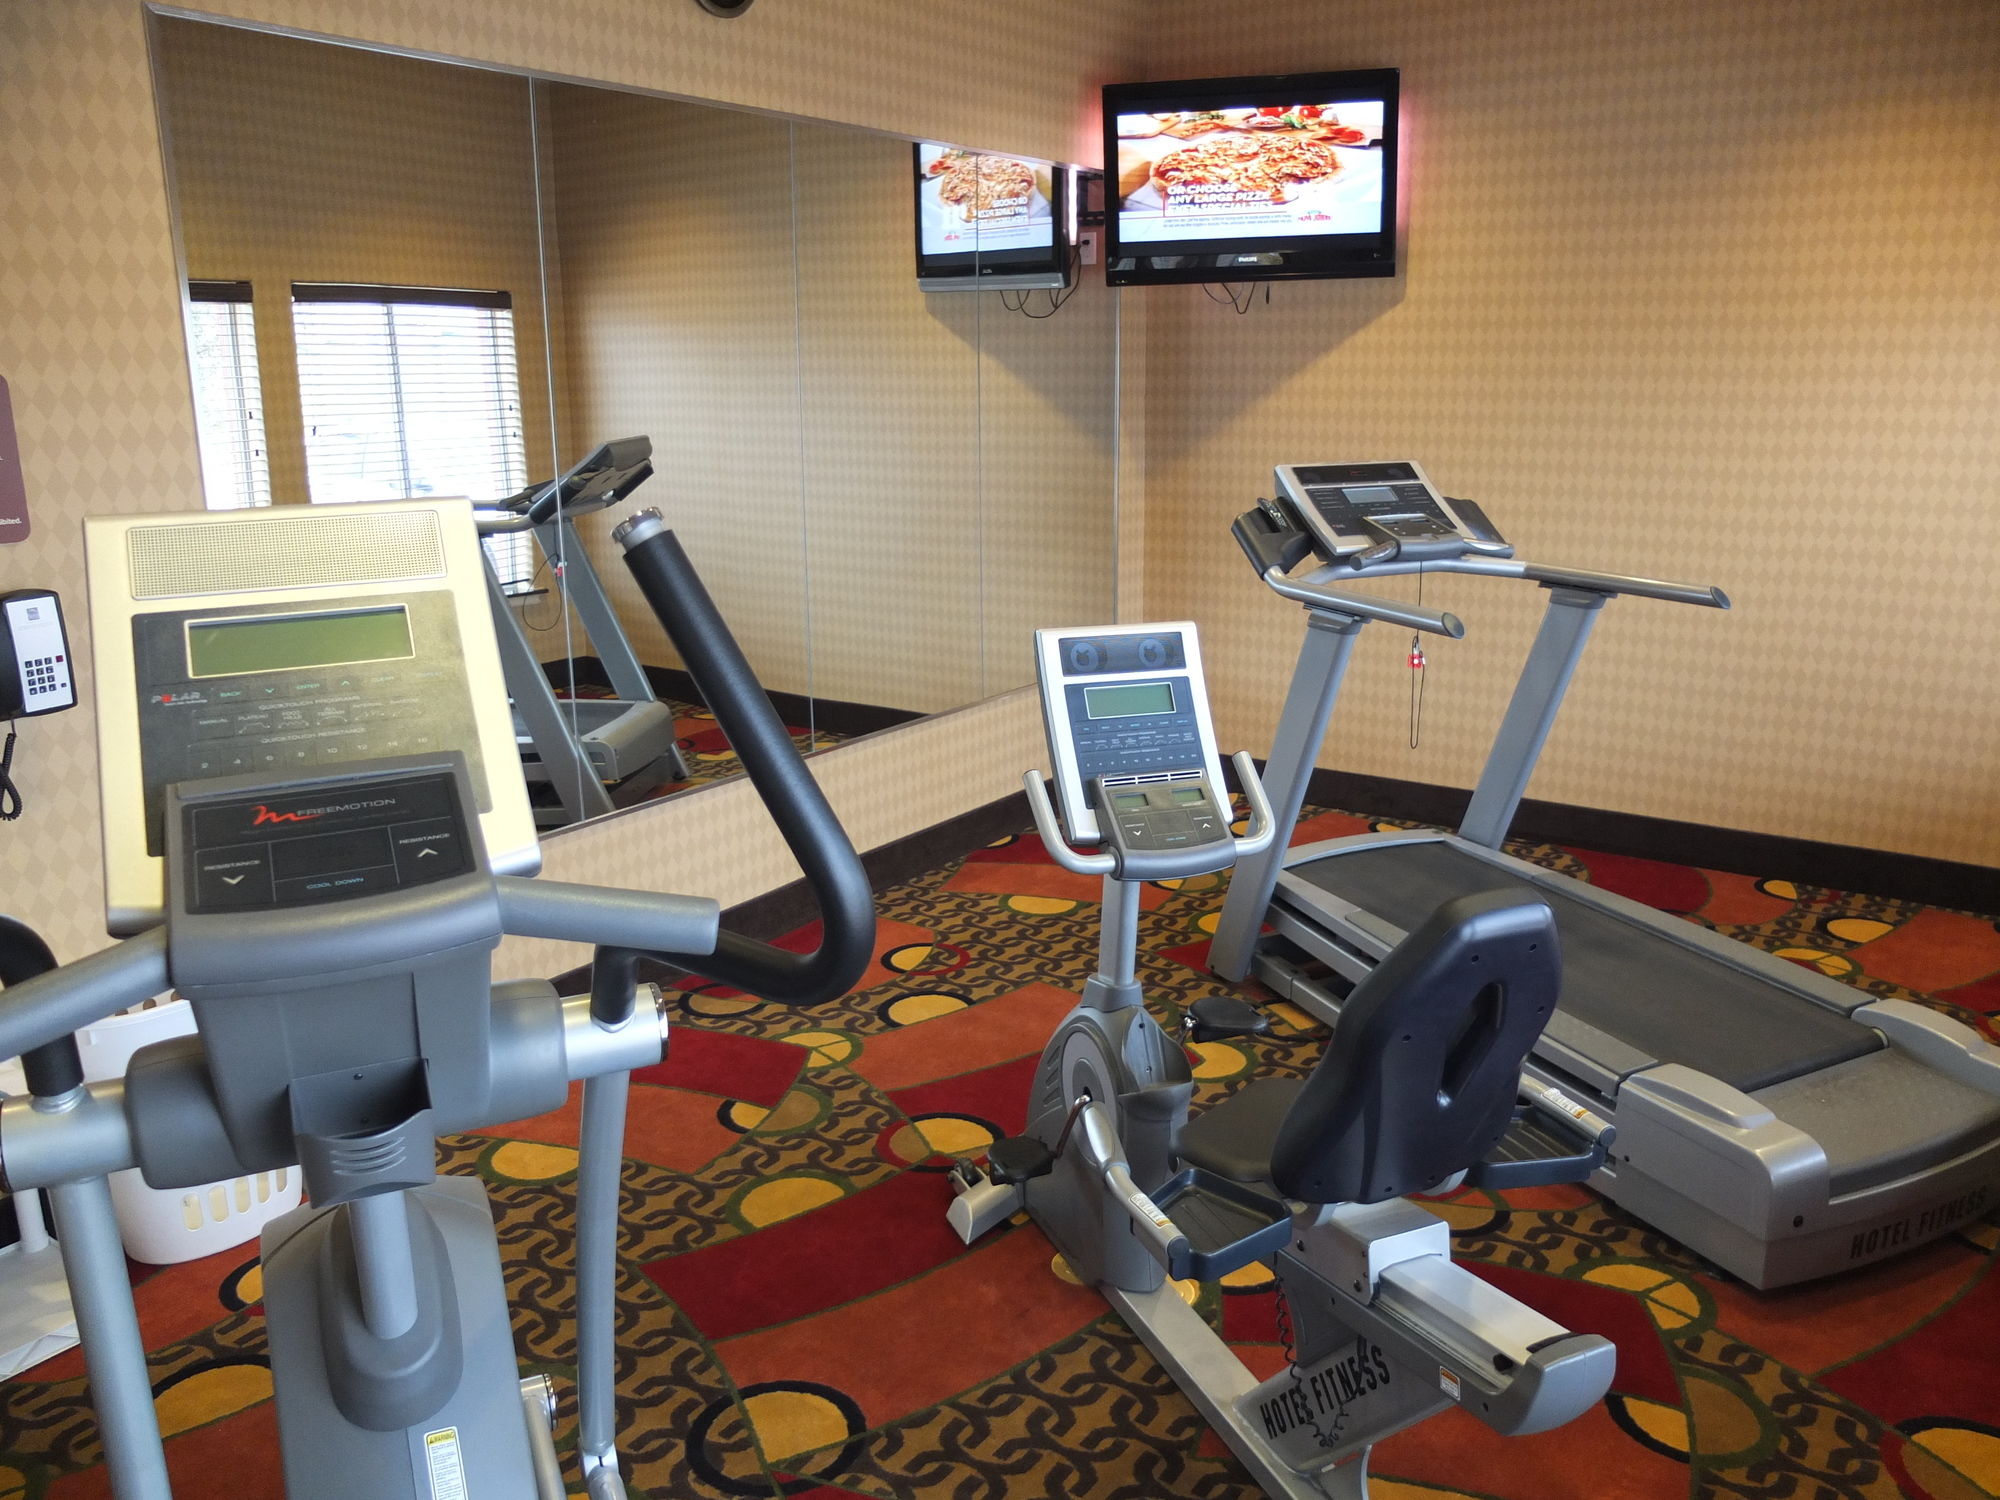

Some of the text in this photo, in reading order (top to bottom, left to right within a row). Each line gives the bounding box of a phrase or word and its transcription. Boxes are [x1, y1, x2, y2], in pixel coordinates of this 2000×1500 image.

[1168, 194, 1194, 204] ANY
[1194, 193, 1234, 203] LARGE
[219, 690, 241, 698] BACK
[296, 797, 397, 817] FREEMOTION
[398, 832, 451, 845] RESISTANCE
[306, 876, 365, 890] COOL DOWN
[1849, 1217, 1911, 1259] HOTEL
[1259, 1384, 1314, 1440] HOTEL
[1309, 1343, 1391, 1415] FITNESS
